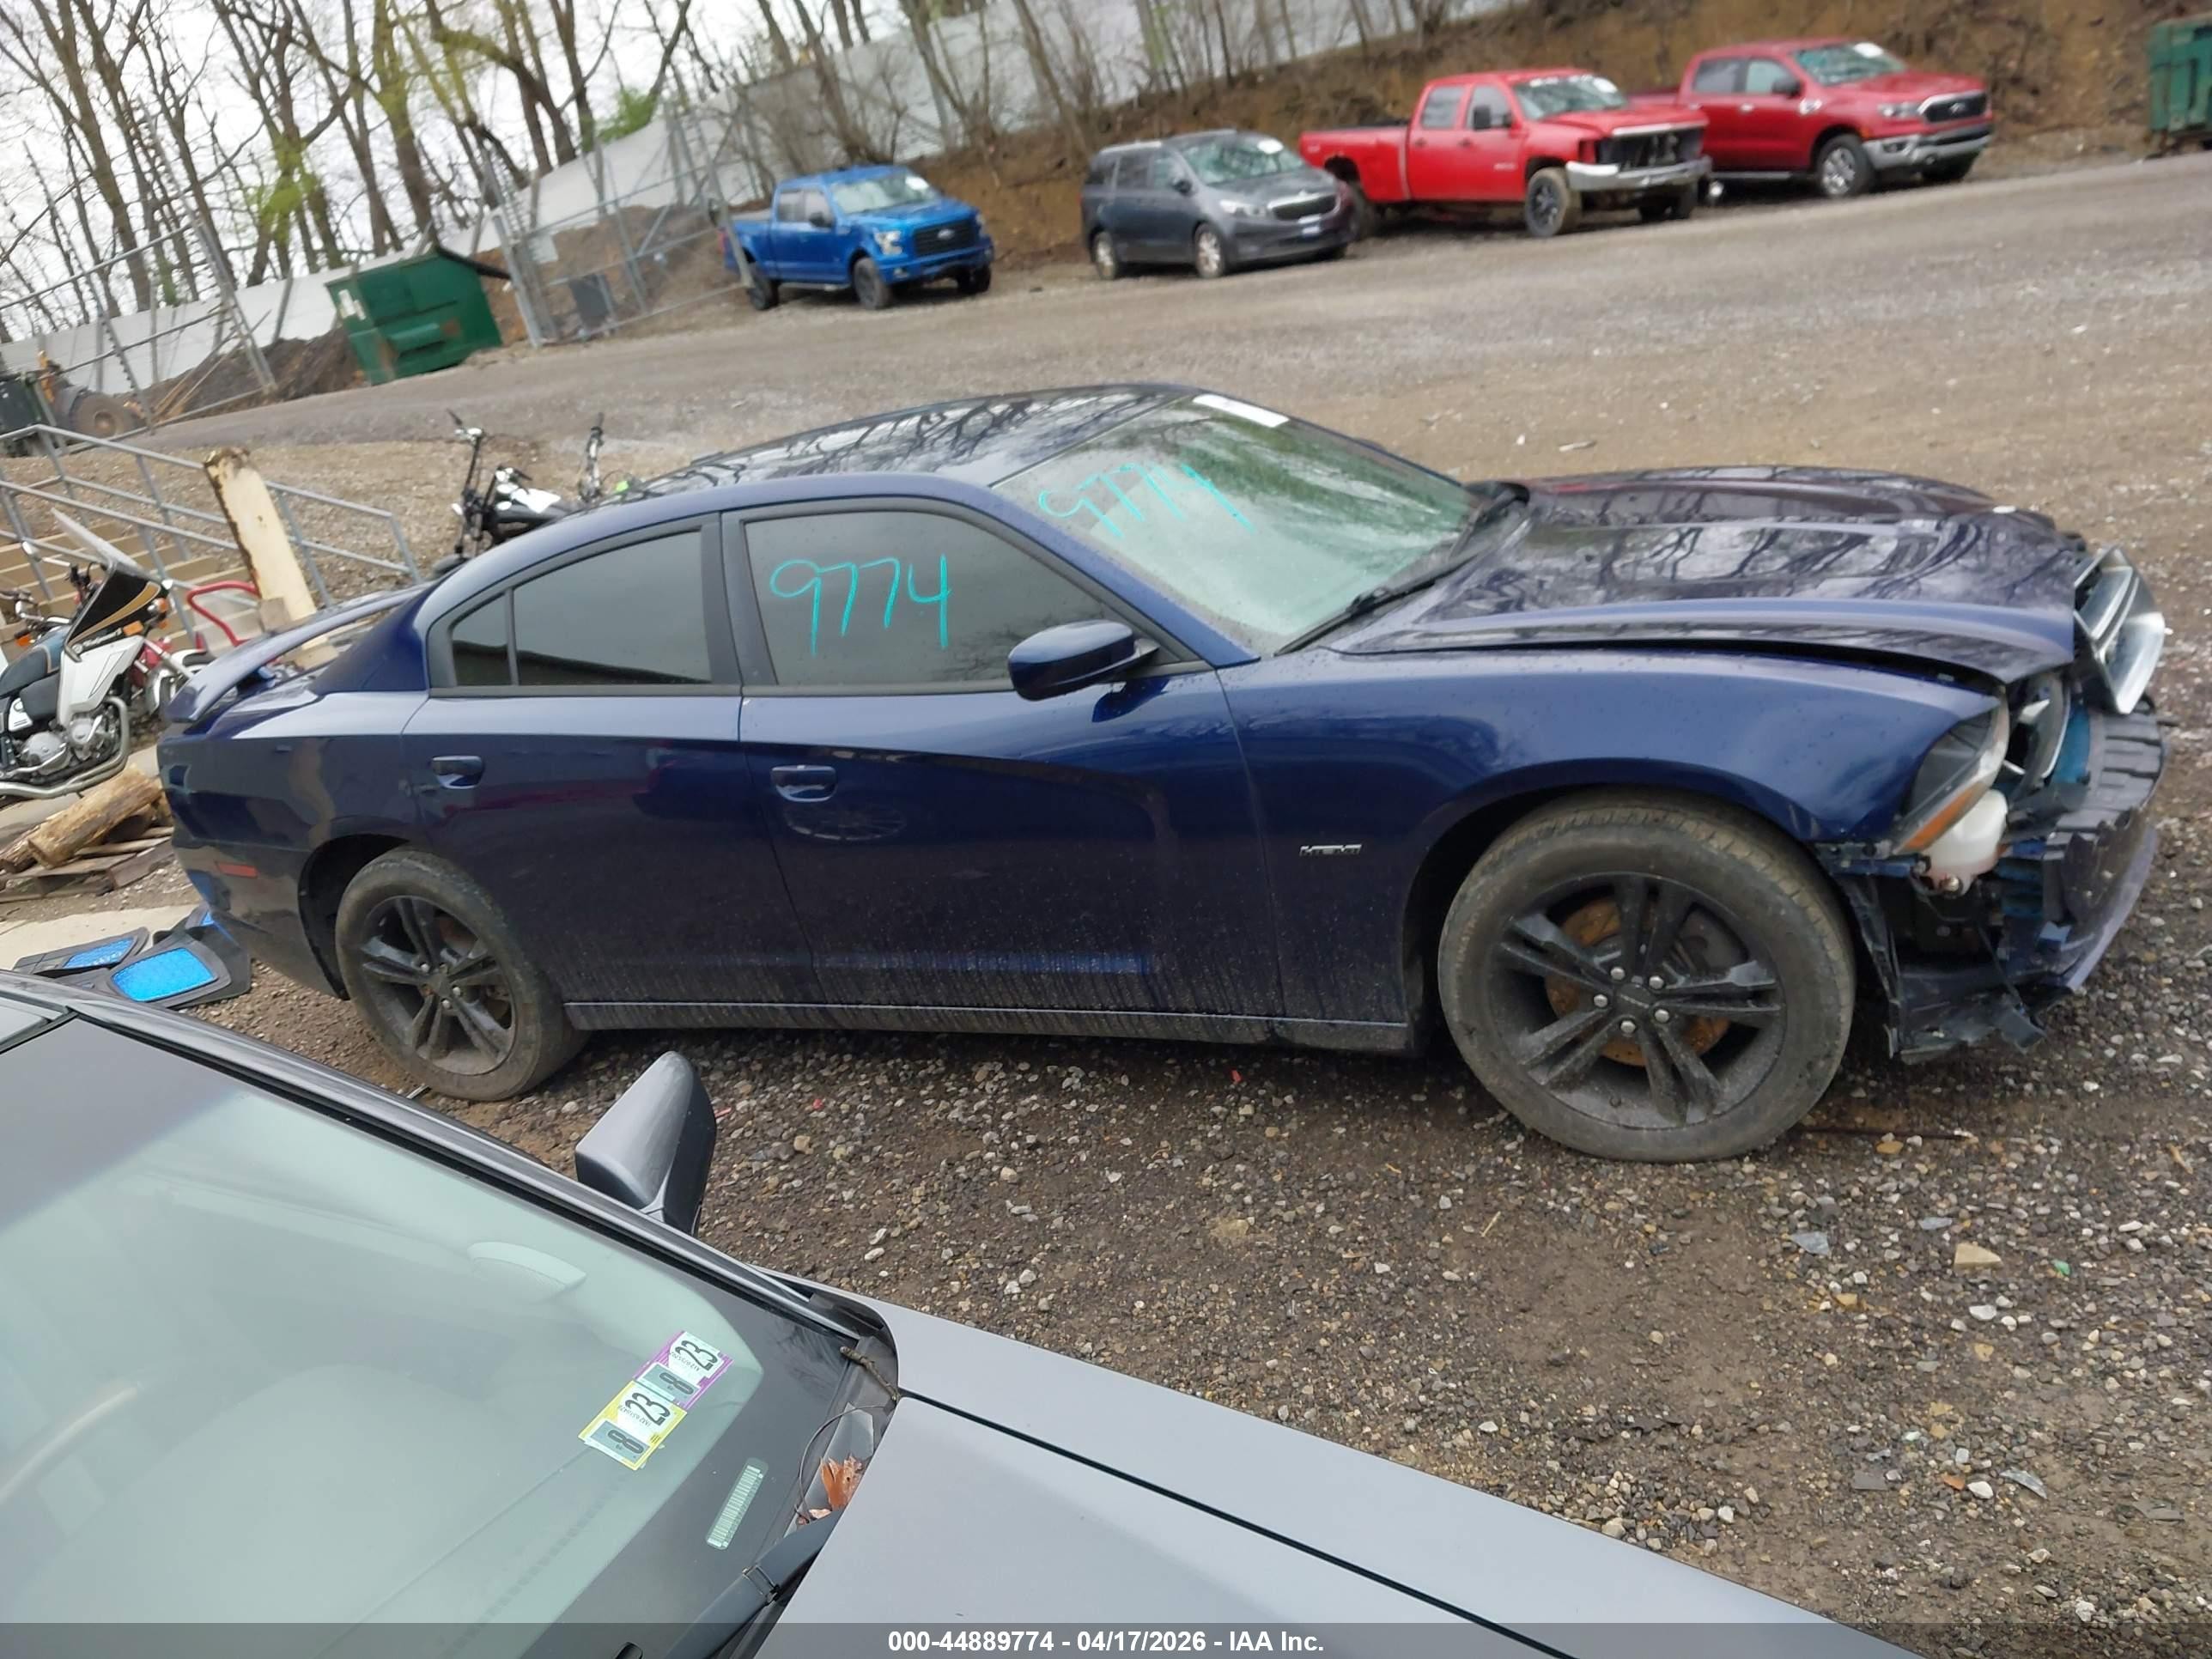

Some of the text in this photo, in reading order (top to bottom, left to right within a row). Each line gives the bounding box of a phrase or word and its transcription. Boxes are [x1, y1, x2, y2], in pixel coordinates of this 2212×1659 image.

[769, 553, 953, 657] 9774
[675, 1340, 718, 1371] 23
[625, 1392, 671, 1426] 23
